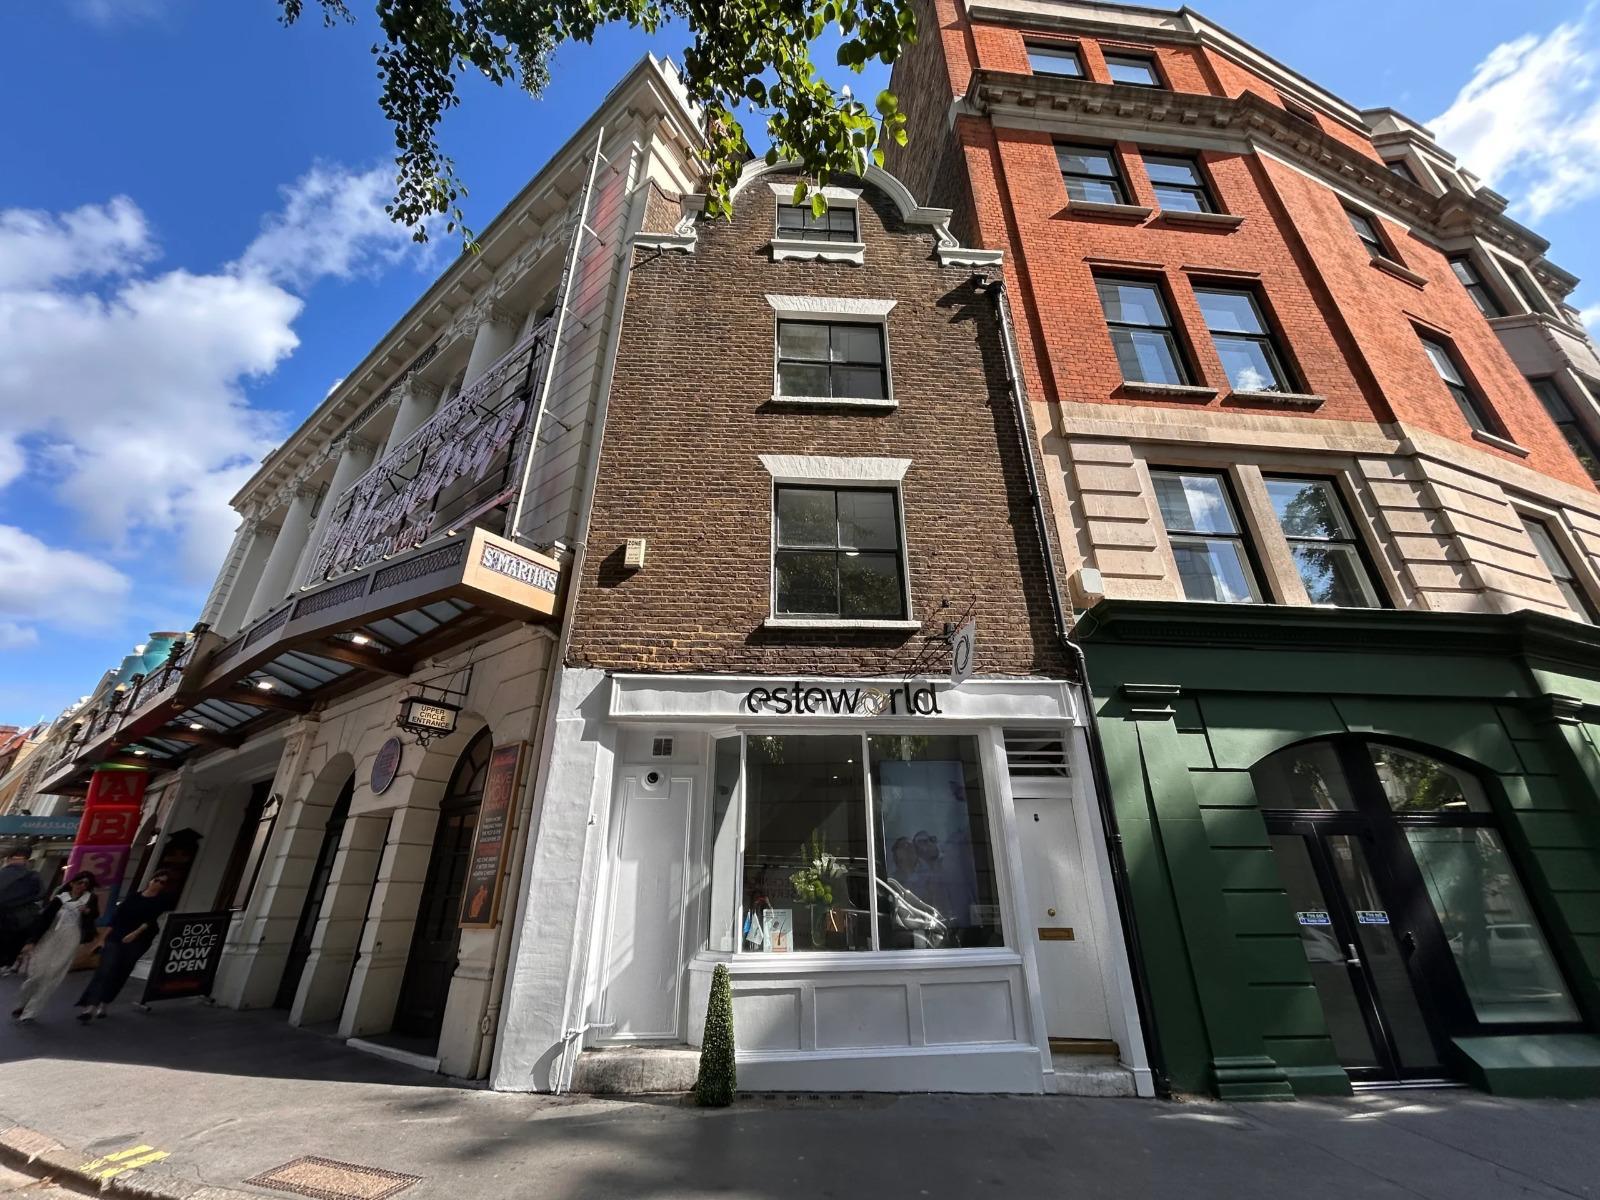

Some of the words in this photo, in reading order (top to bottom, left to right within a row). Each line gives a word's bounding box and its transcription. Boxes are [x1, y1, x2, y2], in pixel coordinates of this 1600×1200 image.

[747, 681, 942, 717] esteworld
[419, 711, 446, 721] CIRCLE
[421, 705, 445, 716] UPPER
[411, 716, 450, 729] ENTRANCE
[182, 923, 213, 936] BOX
[169, 934, 218, 949] OFFICE
[169, 946, 211, 961] NOW
[164, 959, 207, 974] OPEN
